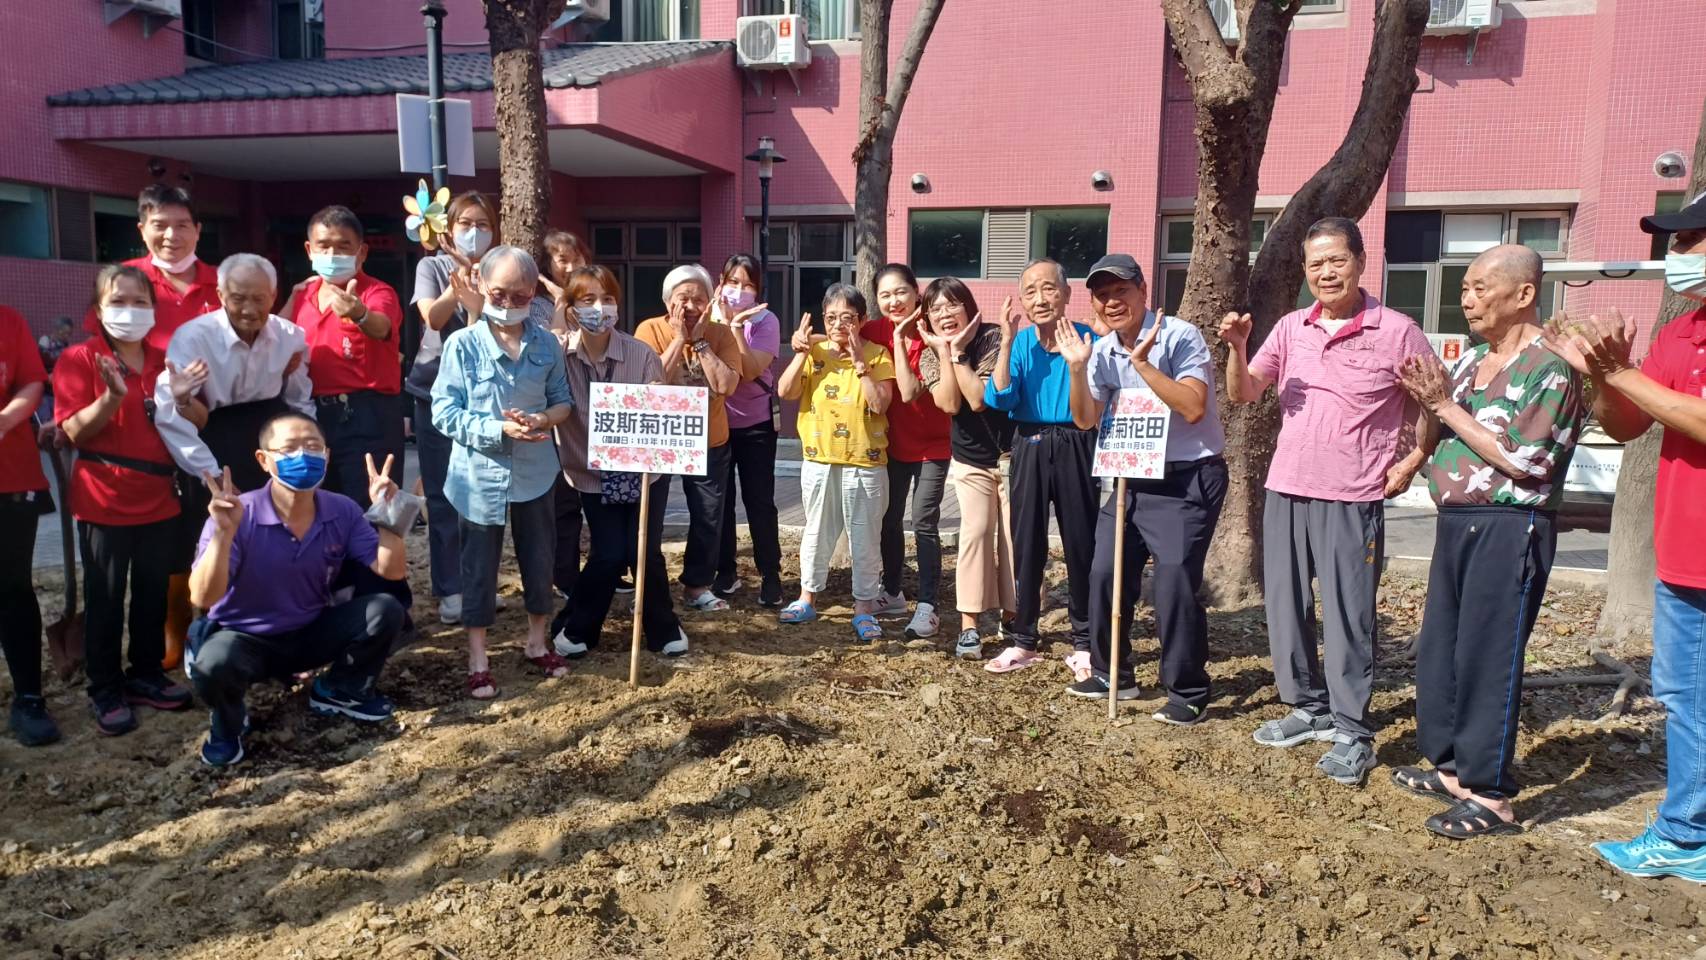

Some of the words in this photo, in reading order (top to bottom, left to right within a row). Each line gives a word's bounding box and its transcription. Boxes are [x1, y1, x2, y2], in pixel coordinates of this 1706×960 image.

[594, 412, 704, 436] 波斯菊花田
